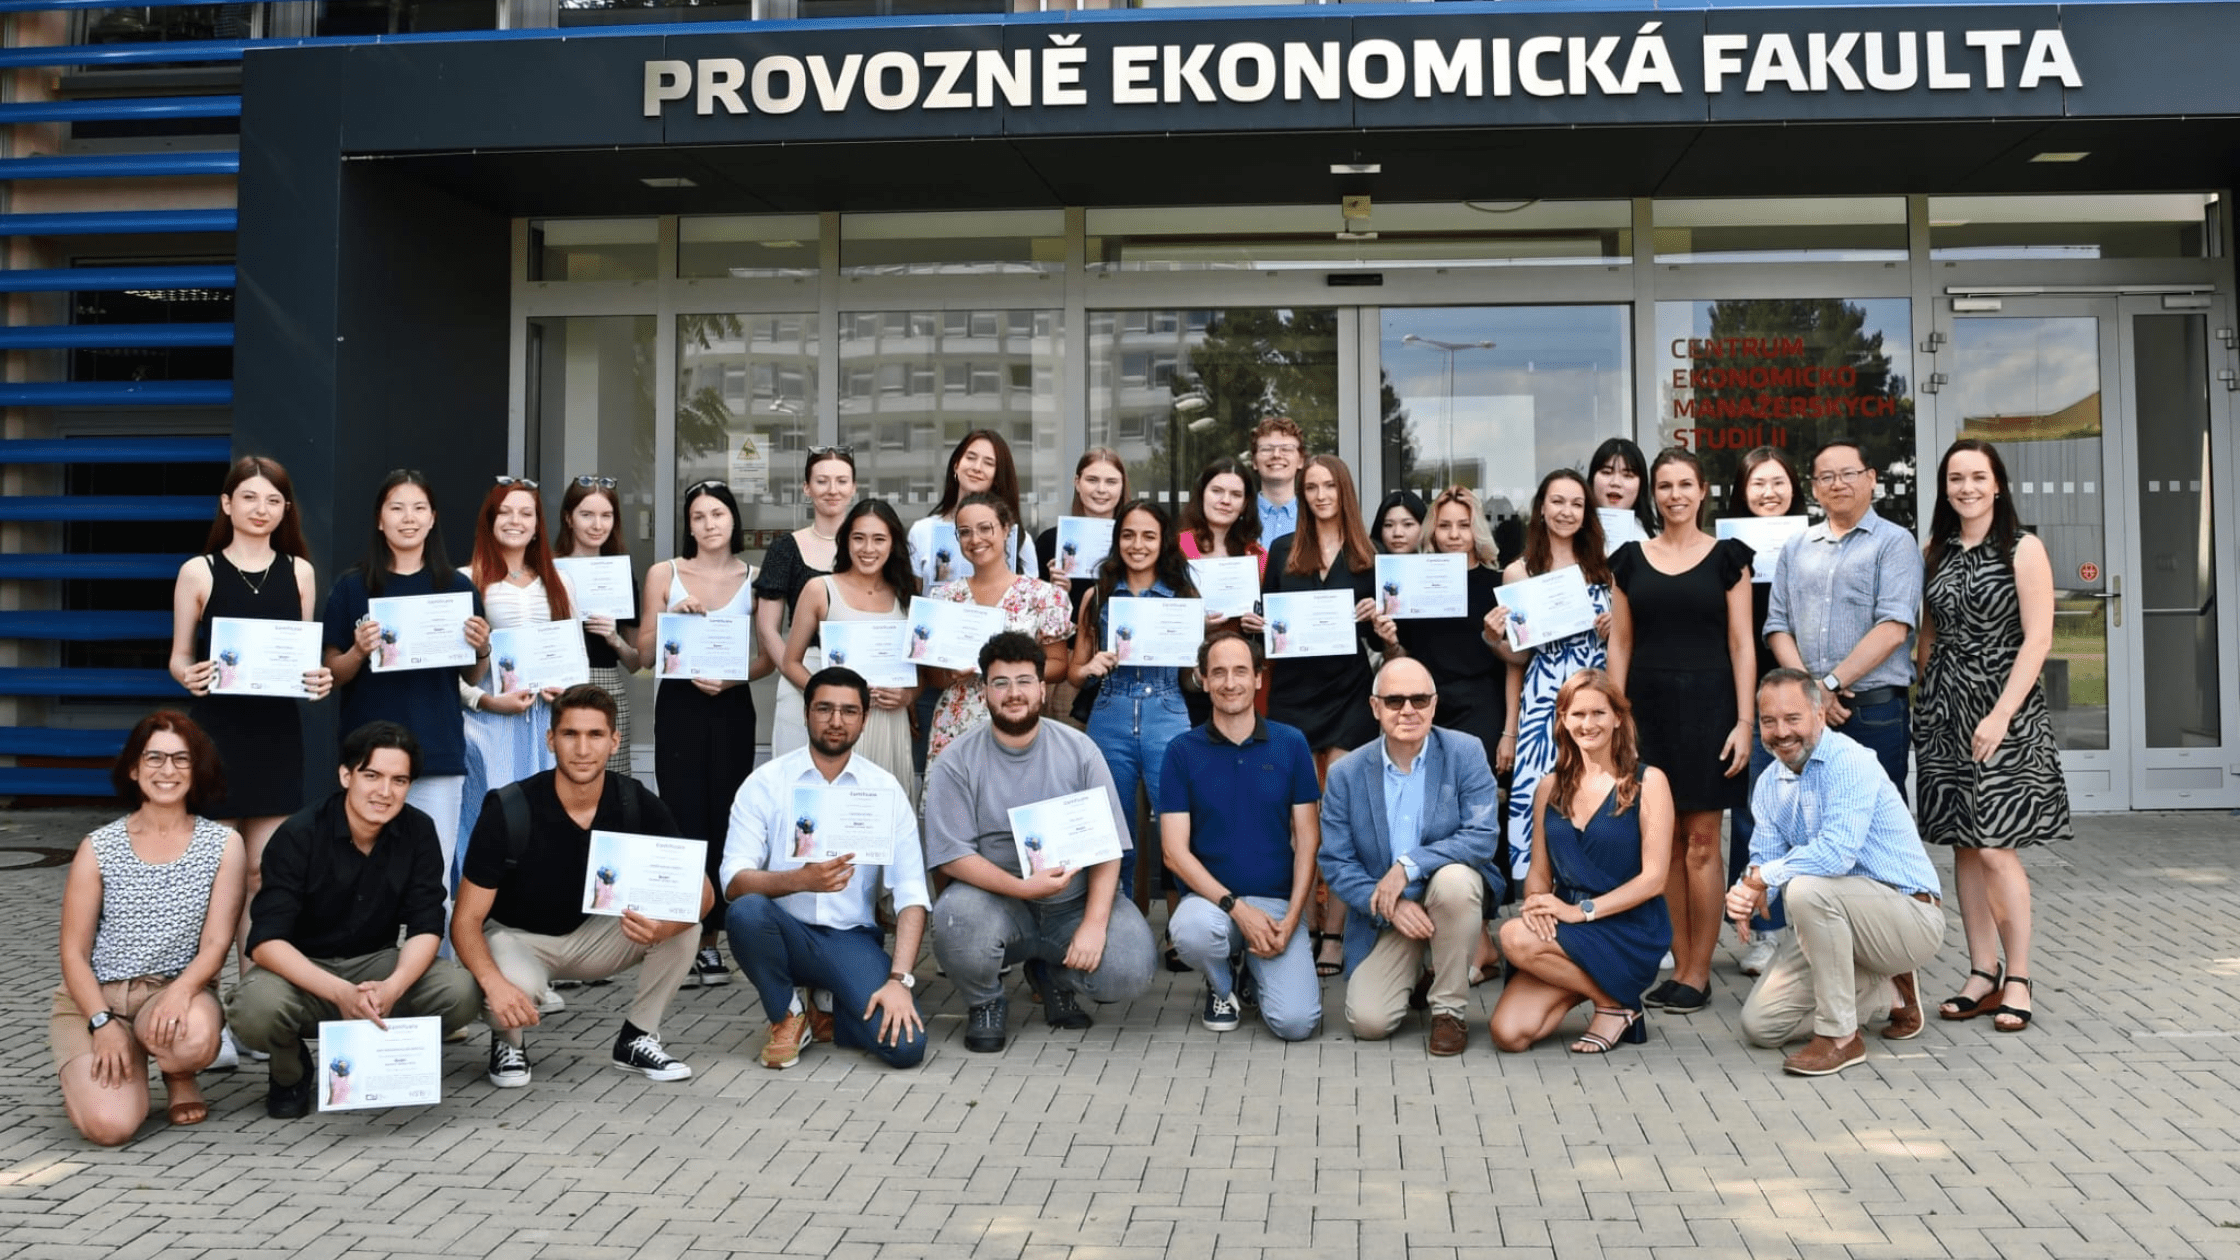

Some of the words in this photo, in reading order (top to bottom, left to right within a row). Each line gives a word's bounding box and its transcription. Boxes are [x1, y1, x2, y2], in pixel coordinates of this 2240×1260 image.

[643, 34, 1087, 117] PROVOZNĚ
[1112, 22, 1683, 104] EKONOMICKÁ
[1703, 28, 2083, 92] FAKULTA
[1671, 337, 1804, 359] CENTRUM
[1673, 366, 1857, 388] EKONOMICKO
[1673, 392, 1896, 418] MANAŽERSKÝCH
